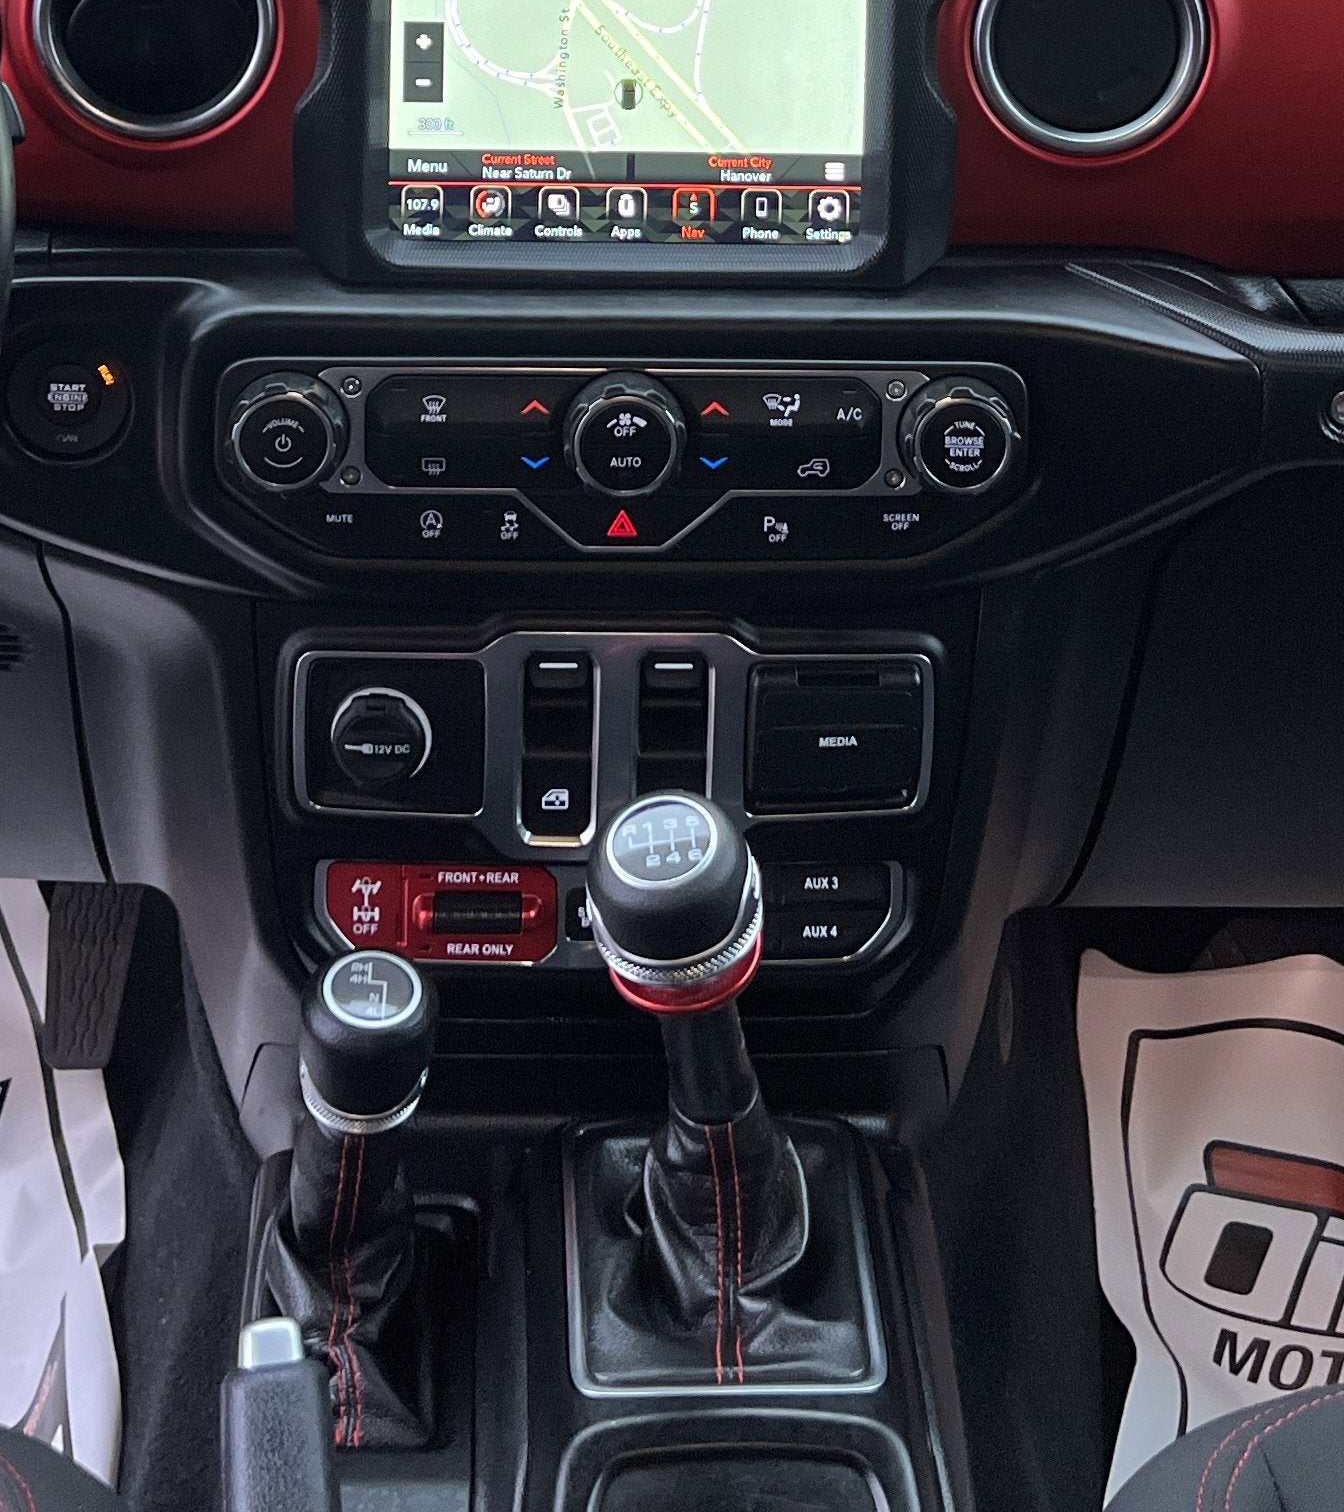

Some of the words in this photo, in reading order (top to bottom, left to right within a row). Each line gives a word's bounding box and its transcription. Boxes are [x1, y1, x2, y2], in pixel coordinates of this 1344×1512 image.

[558, 7, 570, 23] St
[553, 27, 570, 110] Washington
[594, 24, 652, 88] Southeast
[650, 84, 677, 119] Expy
[417, 118, 442, 130] 300
[444, 118, 455, 130] ft
[482, 153, 522, 165] Current
[523, 154, 556, 166] Street
[708, 156, 749, 168] Current
[749, 157, 773, 170] City
[407, 159, 448, 173] Menu
[482, 166, 512, 179] Near
[514, 167, 554, 180] Saturn
[556, 167, 572, 180] Dr
[720, 170, 772, 182] Hanover
[406, 198, 440, 211] 107.9
[689, 202, 698, 215] S
[403, 224, 440, 236] Media
[468, 224, 513, 237] Climate
[534, 224, 583, 237] Controls
[610, 226, 641, 240] Apps
[681, 226, 706, 239] Nav
[742, 226, 779, 239] Phone
[805, 227, 852, 242] Settings
[49, 383, 86, 392] START
[47, 392, 89, 403] ENGINE
[53, 403, 85, 411] STOP
[420, 414, 447, 423] FRONT
[836, 406, 863, 422] A/C
[267, 418, 301, 430] VOLUME
[769, 418, 793, 427] MODE
[953, 420, 976, 430] TUNE
[614, 426, 637, 437] OFF
[944, 436, 985, 445] BROWSE
[949, 448, 981, 457] ENTER
[609, 456, 642, 468] AUTO
[949, 461, 979, 472] SCROLL
[326, 514, 354, 523] MUTE
[883, 513, 920, 522] SCREEN
[763, 516, 776, 533] P
[891, 522, 910, 531] OFF
[421, 529, 442, 539] OFF
[500, 531, 519, 540] OFF
[768, 533, 787, 543] OFF
[818, 736, 858, 748] MEDIA
[374, 744, 392, 754] 12V
[394, 744, 411, 754] DC
[643, 821, 652, 832] 1
[663, 818, 678, 830] 3
[685, 816, 700, 828] 5
[622, 825, 637, 836] R
[665, 851, 681, 864] 4
[688, 848, 704, 861] 6
[646, 854, 662, 868] 2
[804, 877, 828, 889] AUX
[831, 876, 839, 889] 3
[353, 923, 378, 935] OFF
[802, 925, 828, 938] AUX
[829, 925, 838, 938] 4
[446, 944, 480, 955] REAR
[482, 944, 514, 956] ONLY
[349, 973, 368, 984] 4H
[368, 992, 380, 1002] N
